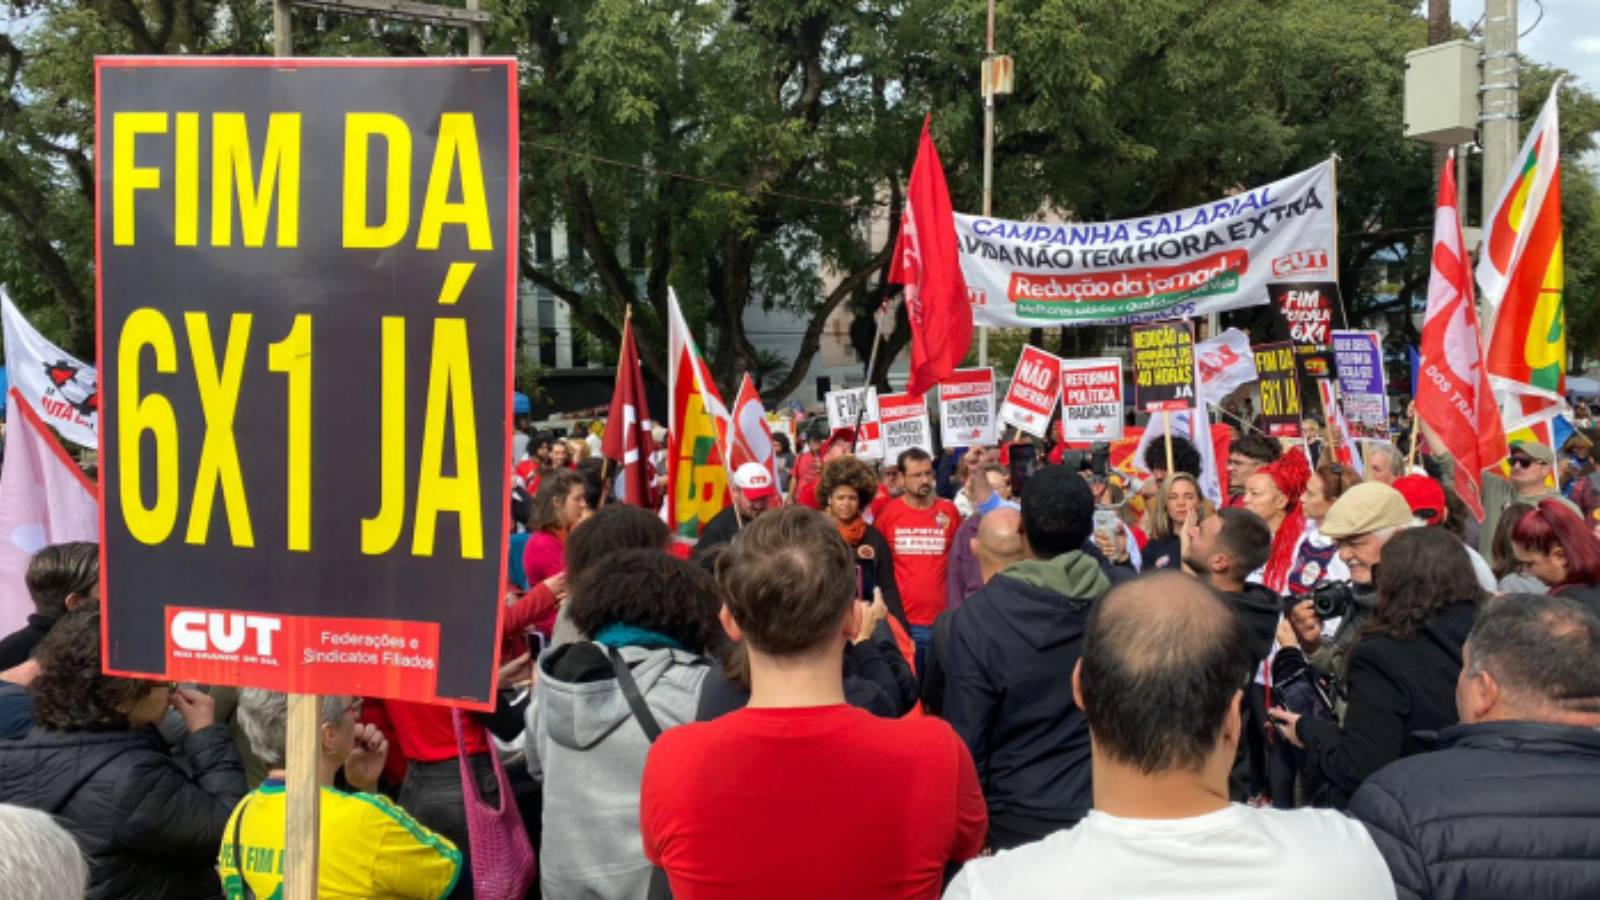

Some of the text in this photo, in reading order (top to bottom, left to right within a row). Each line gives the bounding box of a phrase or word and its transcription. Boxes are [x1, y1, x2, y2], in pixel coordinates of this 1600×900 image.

[113, 112, 493, 250] FIM DA
[972, 188, 1279, 246] CAMPANHA SALARIAL
[1013, 245, 1073, 269] NÃO
[1079, 246, 1135, 269] TEM
[1136, 231, 1225, 262] HORA
[1227, 187, 1323, 241] EXTRA
[1272, 250, 1328, 277] CUT
[1015, 277, 1109, 302] Redução
[1113, 273, 1143, 296] da
[1144, 256, 1240, 297] jornad
[1286, 290, 1320, 308] FIM
[1290, 321, 1327, 343] 6X1
[1255, 351, 1278, 372] FIM
[1279, 348, 1295, 371] DA
[1018, 359, 1052, 391] NÃO
[1065, 370, 1116, 386] REFORMA
[1153, 366, 1193, 386] HORAS
[1425, 364, 1452, 392] DOS
[117, 308, 312, 551] 6X1
[360, 263, 484, 559] JÁ
[1068, 404, 1117, 419] RADICAL!
[171, 610, 282, 656] CUT
[321, 631, 420, 650] Federações e
[303, 648, 435, 670] Sindicatos Filiados
[246, 846, 274, 873] FIM
